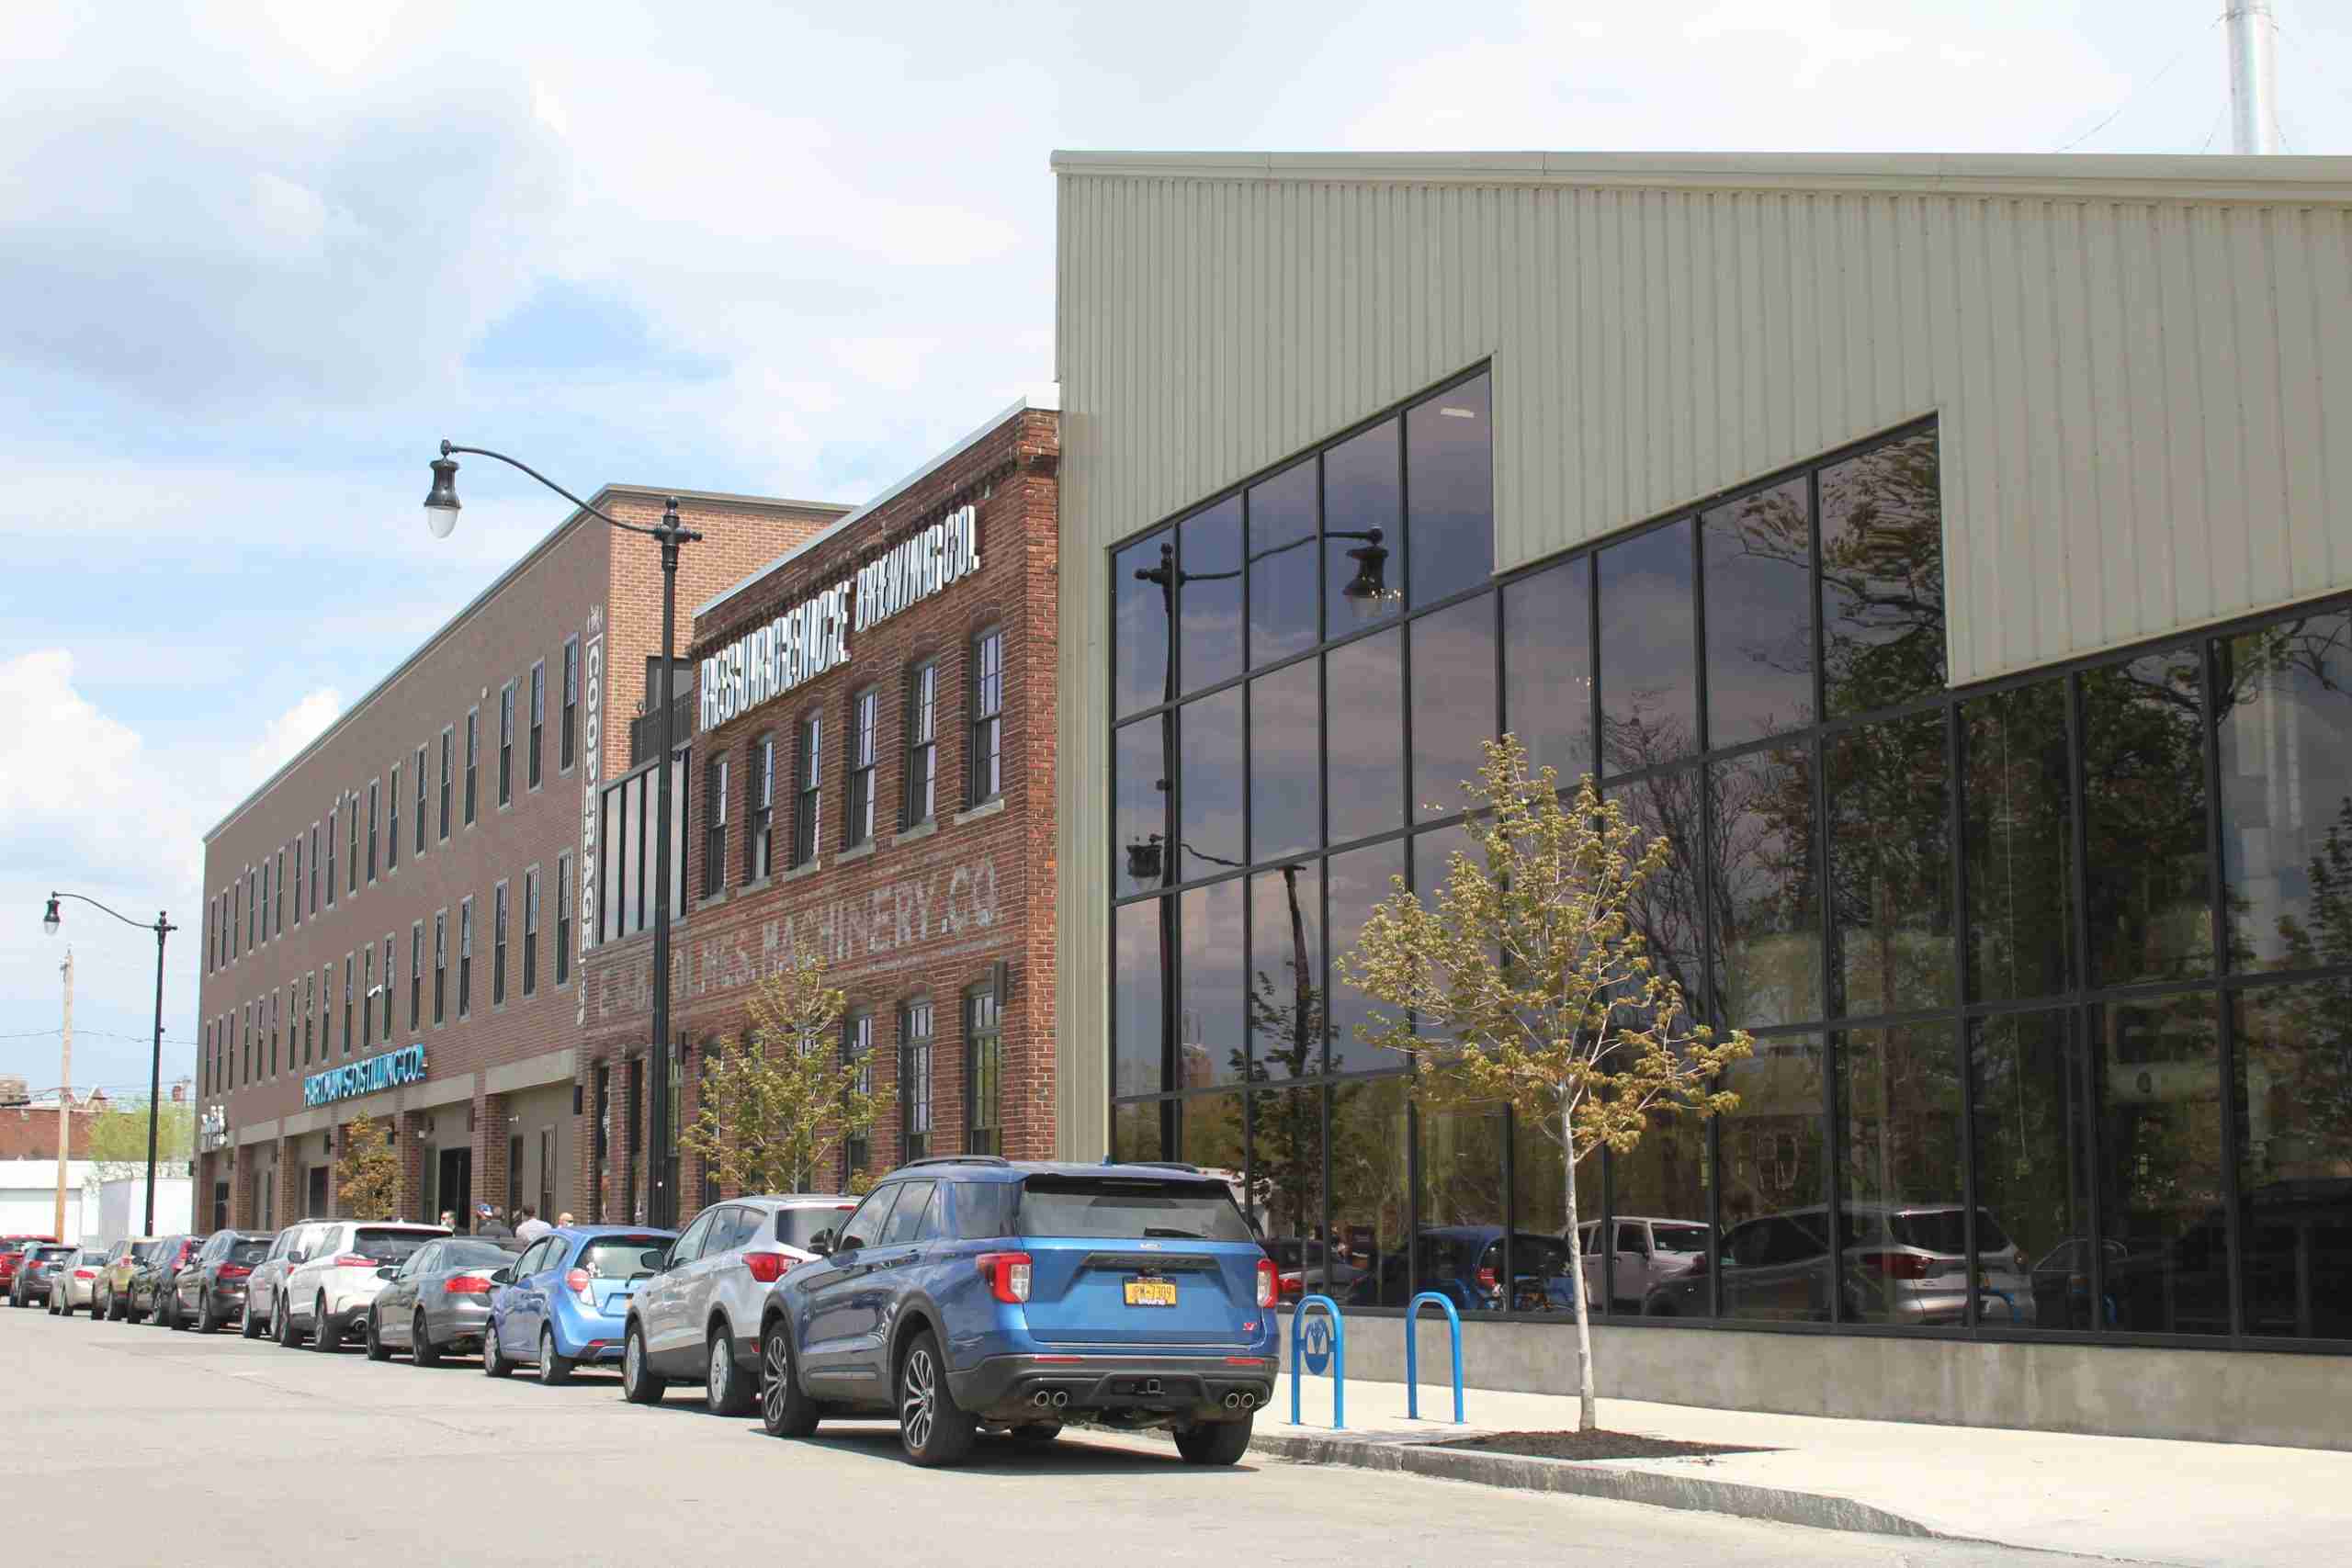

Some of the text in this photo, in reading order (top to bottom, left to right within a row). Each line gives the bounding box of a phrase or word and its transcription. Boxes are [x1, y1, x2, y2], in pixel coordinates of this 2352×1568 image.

[700, 580, 853, 734] RESURGENCE
[854, 525, 944, 632] BREWING
[582, 645, 599, 953] COOPERAGE
